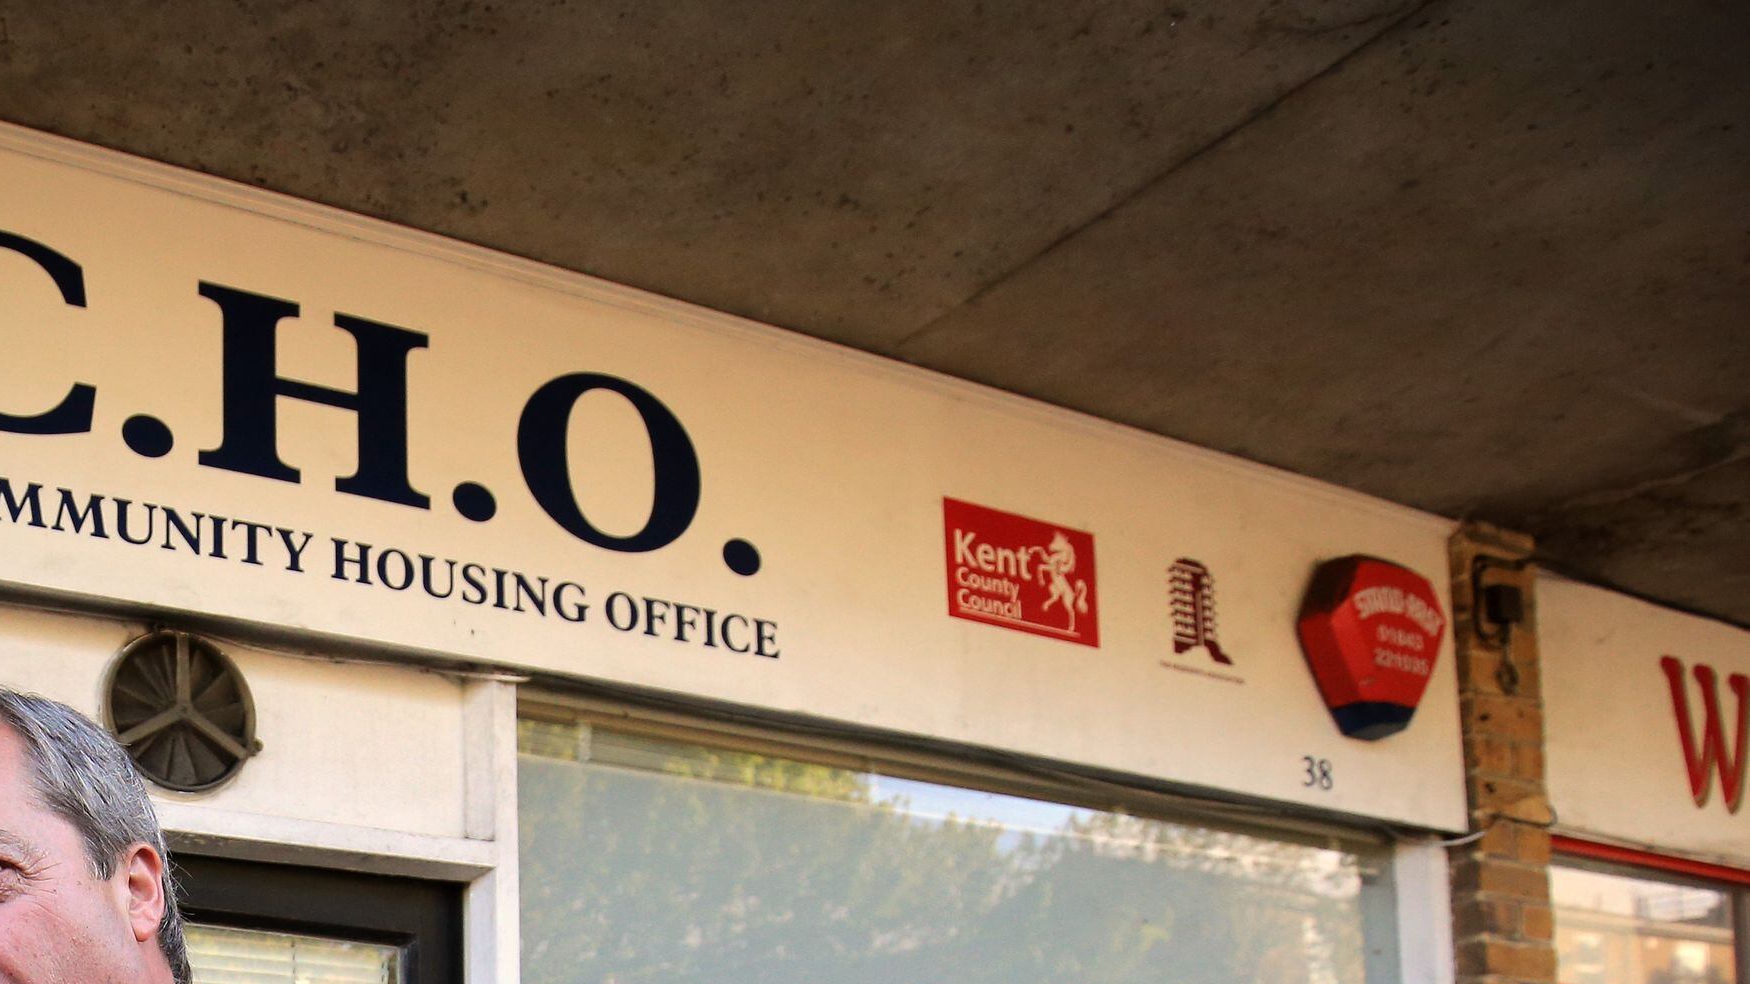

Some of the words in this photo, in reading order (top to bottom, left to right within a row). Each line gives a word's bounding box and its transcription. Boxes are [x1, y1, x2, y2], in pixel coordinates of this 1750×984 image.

[954, 528, 1032, 581] Kent
[329, 537, 590, 625] HOUSING
[604, 592, 782, 661] OFFICE
[956, 566, 1020, 603] County
[957, 588, 1022, 619] Council
[1302, 755, 1333, 791] 38
